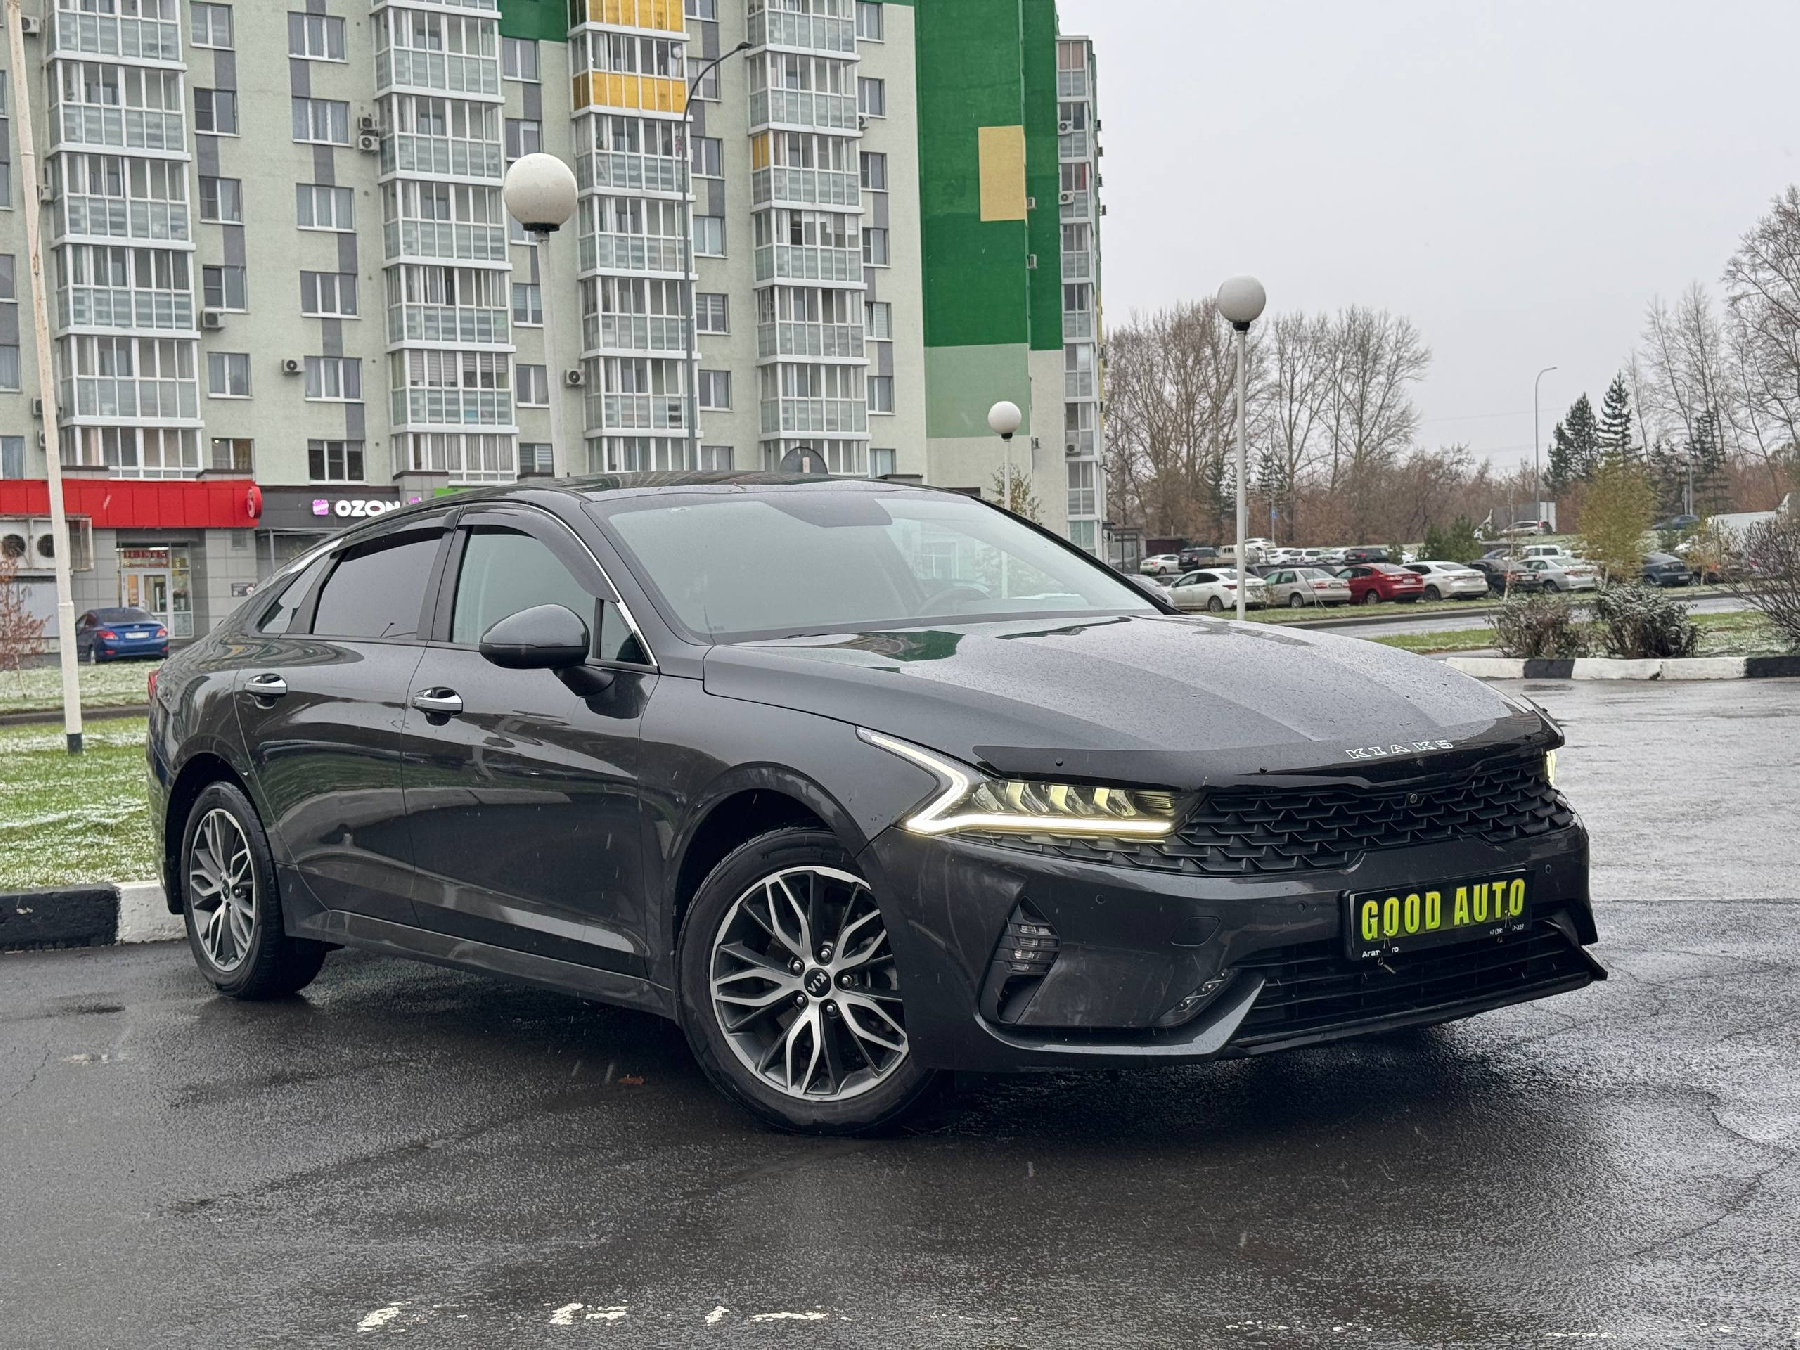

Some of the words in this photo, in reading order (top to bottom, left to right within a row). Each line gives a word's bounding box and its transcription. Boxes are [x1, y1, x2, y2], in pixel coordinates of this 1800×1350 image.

[1345, 744, 1411, 760] KIA
[1412, 739, 1454, 751] K5
[1361, 890, 1442, 942] GOOD
[1453, 877, 1526, 926] AUTO
[807, 972, 828, 993] KIA
